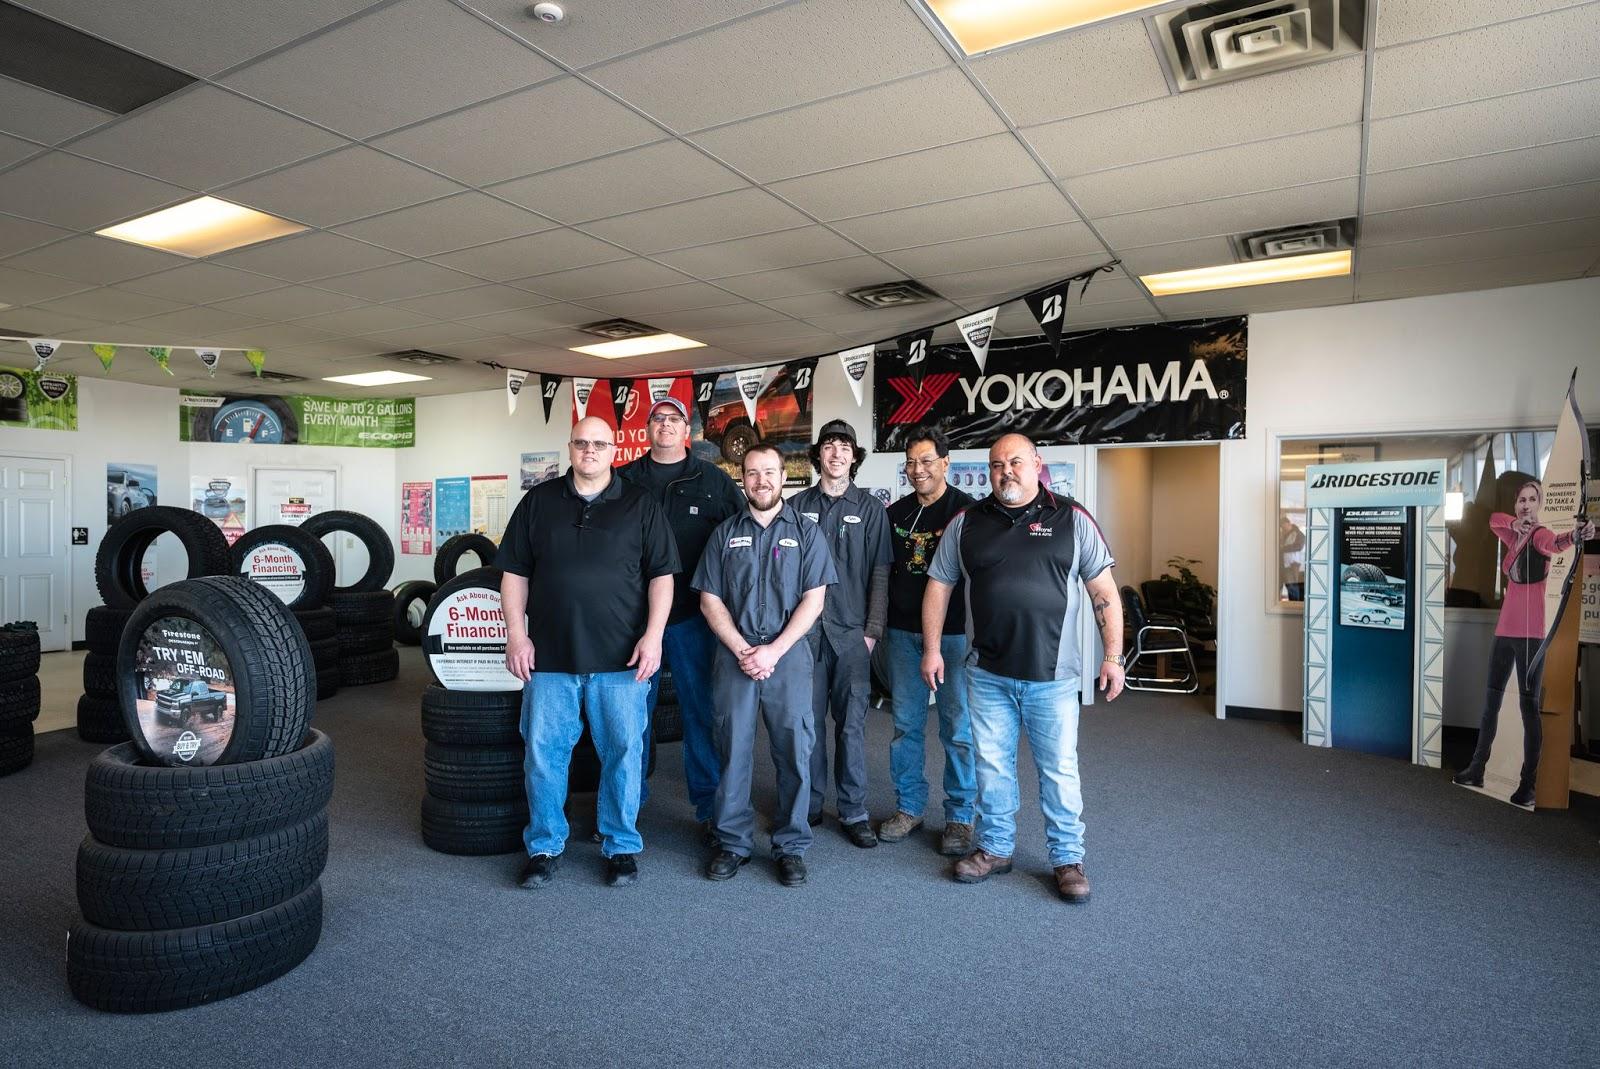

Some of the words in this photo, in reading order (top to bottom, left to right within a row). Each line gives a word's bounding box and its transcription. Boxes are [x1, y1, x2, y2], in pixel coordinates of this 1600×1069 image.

[304, 401, 331, 413] SAVE
[334, 402, 349, 413] UP
[352, 403, 364, 414] TO
[367, 404, 375, 415] 2
[377, 403, 413, 416] GALLONS
[304, 413, 337, 425] EVERY
[340, 416, 379, 427] MONTH
[226, 428, 233, 437] E
[629, 428, 647, 443] YO
[1310, 470, 1441, 488] BRIDGESTONE
[253, 555, 293, 564] 6-Month
[252, 563, 298, 574] Financing
[456, 593, 467, 603] Ask
[489, 595, 501, 603] Our
[448, 606, 504, 622] 6-Mont
[162, 629, 201, 640] Firestone
[152, 646, 178, 662] TRY
[181, 649, 205, 666] 'EM
[176, 662, 225, 680] OFF-ROAD
